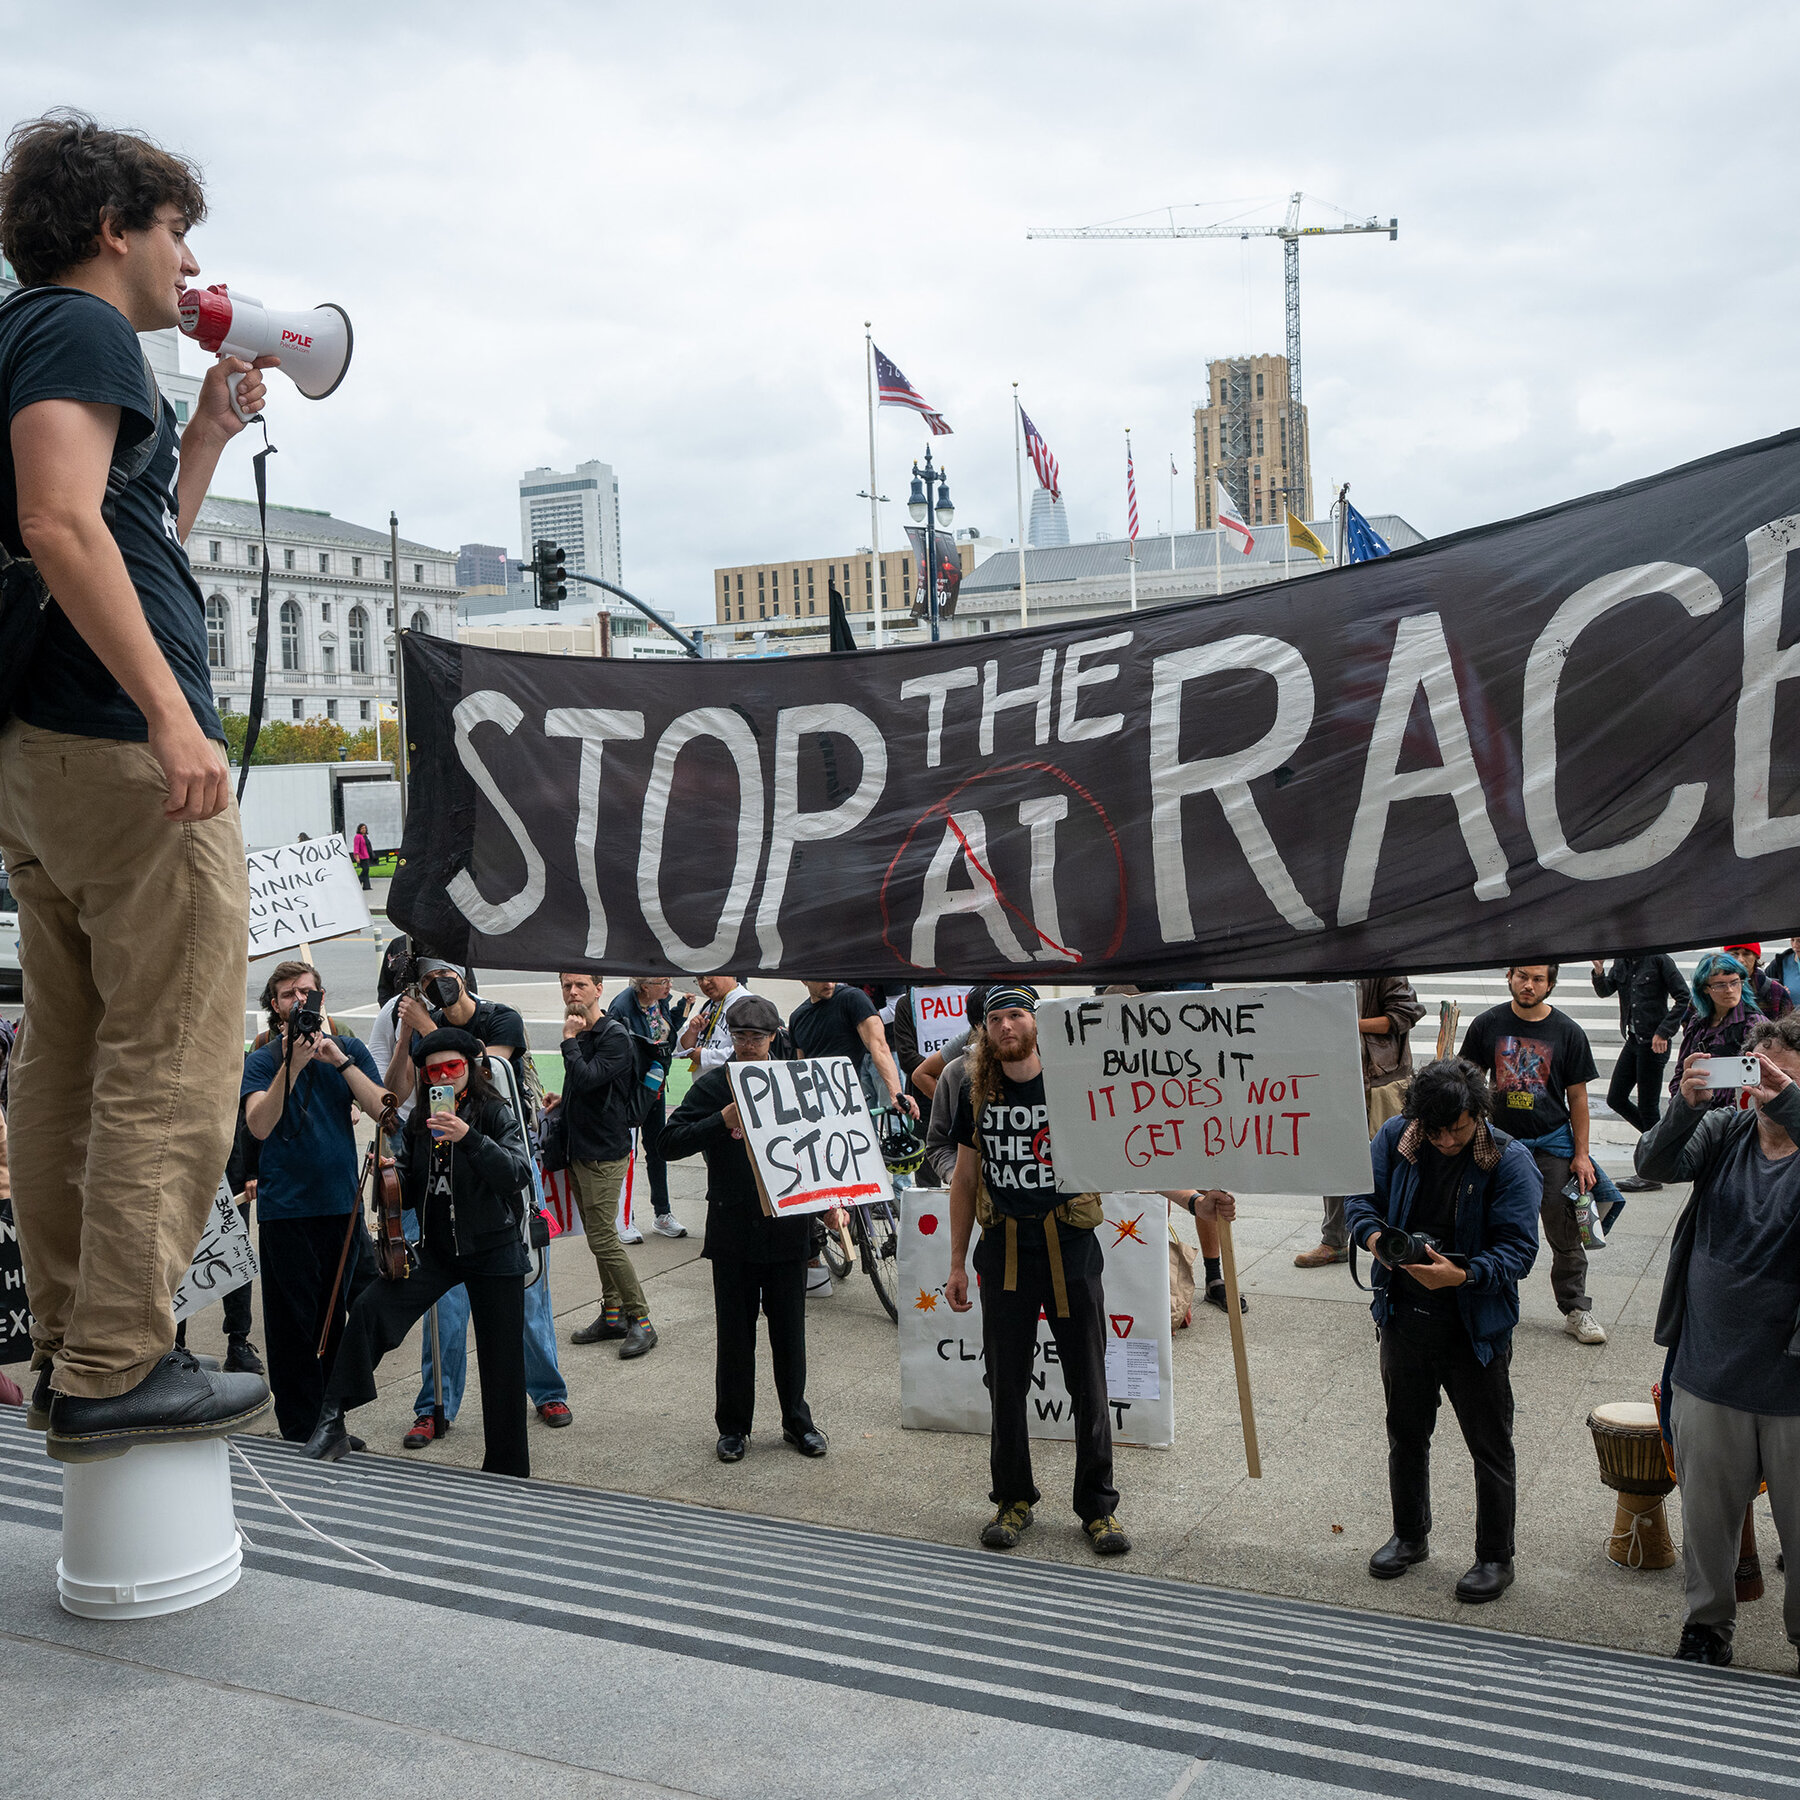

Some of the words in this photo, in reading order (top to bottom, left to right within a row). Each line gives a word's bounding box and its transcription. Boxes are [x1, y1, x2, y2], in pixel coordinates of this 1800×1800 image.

[282, 330, 314, 348] PYLE
[886, 364, 900, 378] 76
[900, 630, 1135, 769] THE
[1149, 513, 1800, 944] RACE
[445, 689, 888, 973] STOP
[246, 850, 280, 874] AY
[288, 838, 348, 866] YOUR
[249, 868, 333, 899] AINING
[909, 793, 1083, 969] AI
[249, 896, 309, 917] UNS
[248, 912, 336, 944] FAIL
[920, 994, 968, 1020] PAU
[1064, 1002, 1104, 1045] IF
[1120, 1003, 1171, 1045] NO
[1179, 1003, 1264, 1037] ONE
[1103, 1049, 1202, 1078] BUILDS
[1217, 1050, 1254, 1081] IT
[739, 1060, 862, 1129] PLEASE
[1087, 1085, 1115, 1121] IT
[1131, 1077, 1223, 1114] DOES
[1248, 1074, 1320, 1105] NOT
[982, 1104, 1049, 1130] STOP
[982, 1134, 1034, 1160] THE
[1125, 1119, 1185, 1167] GET
[1203, 1112, 1311, 1157] BUILT
[766, 1129, 871, 1197] STOP
[983, 1160, 1055, 1190] RACE
[428, 1175, 452, 1196] RA
[215, 1195, 238, 1235] PAUSE
[1034, 1398, 1131, 1430] WT
